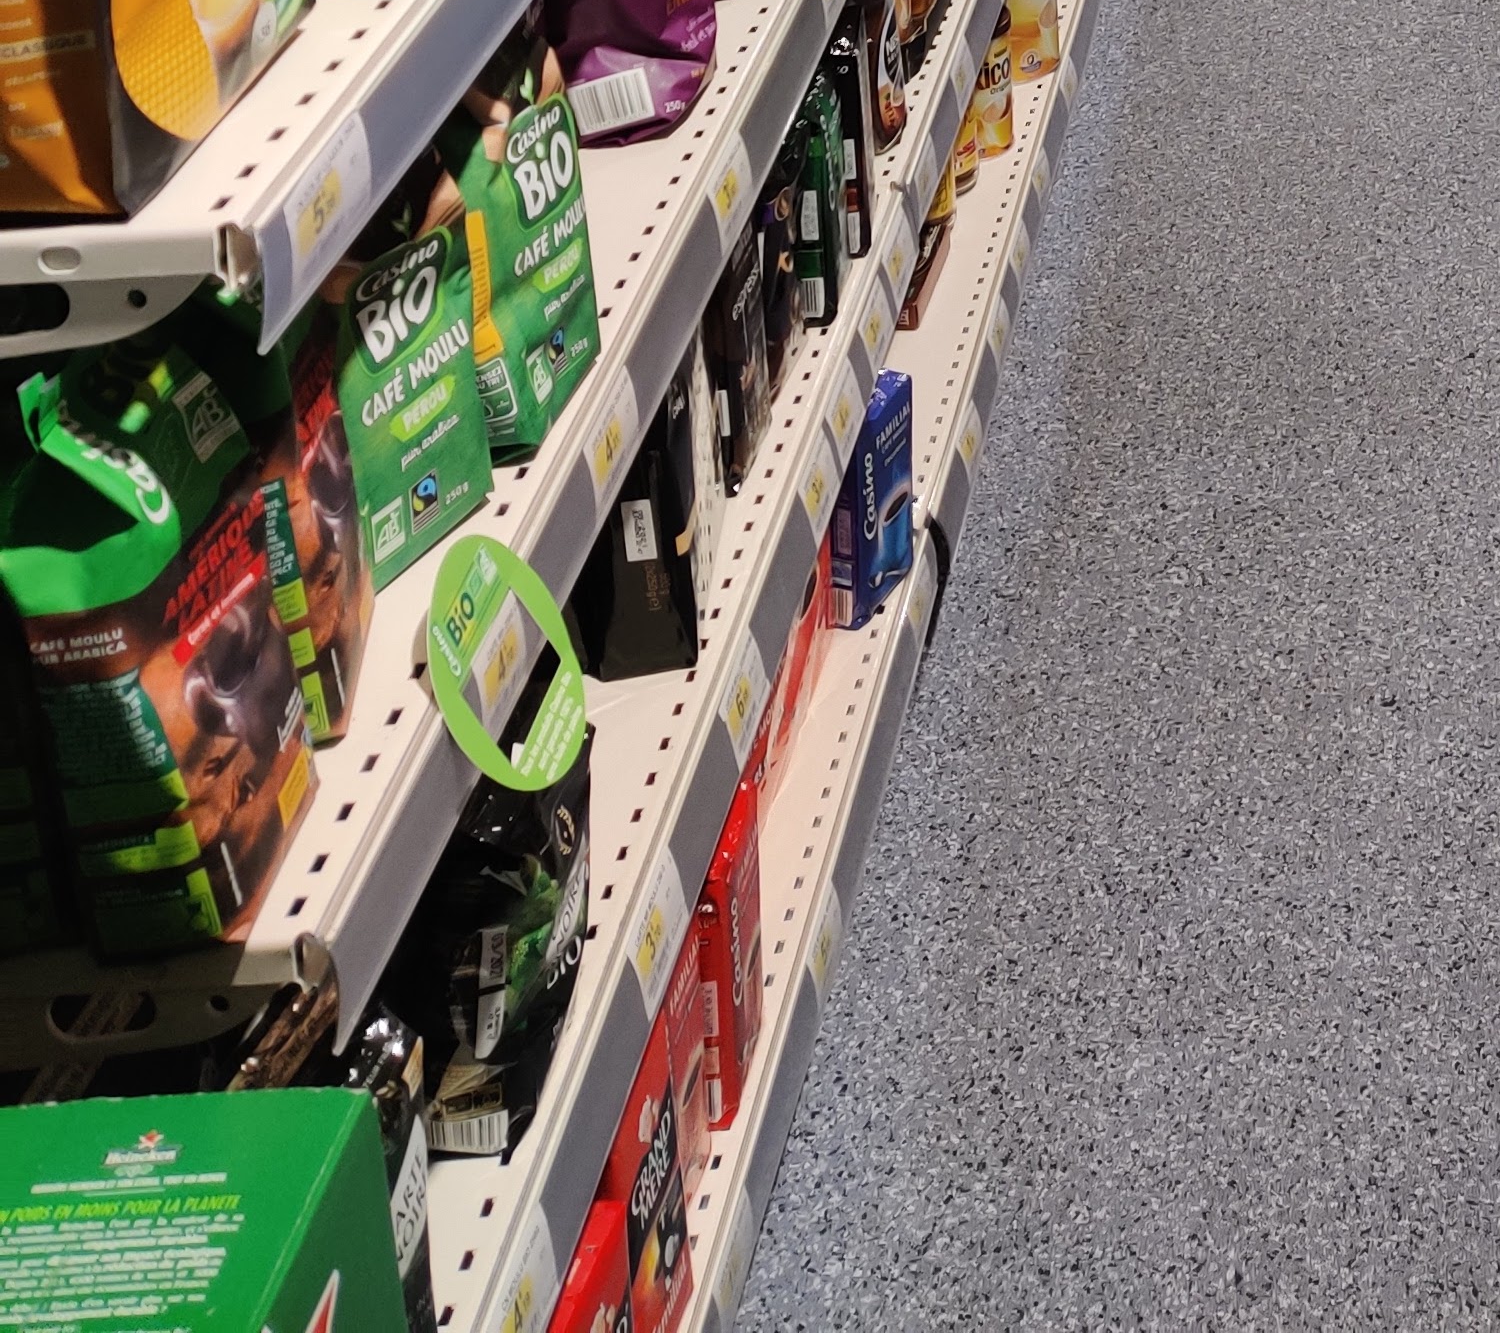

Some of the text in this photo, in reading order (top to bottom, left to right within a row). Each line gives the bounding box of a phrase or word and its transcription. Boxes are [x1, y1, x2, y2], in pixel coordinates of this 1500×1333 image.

[506, 103, 561, 164] Casino
[513, 130, 574, 220] BiO
[355, 238, 439, 302] Casino
[513, 225, 550, 277] CAFÉ
[355, 264, 438, 366] BiO
[360, 317, 471, 429] CAFÉ MOULU
[402, 386, 447, 433] PEROU
[401, 413, 462, 472] pur arabica
[863, 451, 877, 542] Casino
[29, 627, 123, 655] CAFÉ MOULU
[446, 591, 475, 648] BiO
[63, 640, 128, 664] ARABICA
[730, 895, 744, 1007] Casino
[630, 1108, 672, 1218] GRAND
[122, 1199, 162, 1215] POUR
[162, 1197, 182, 1213] LA
